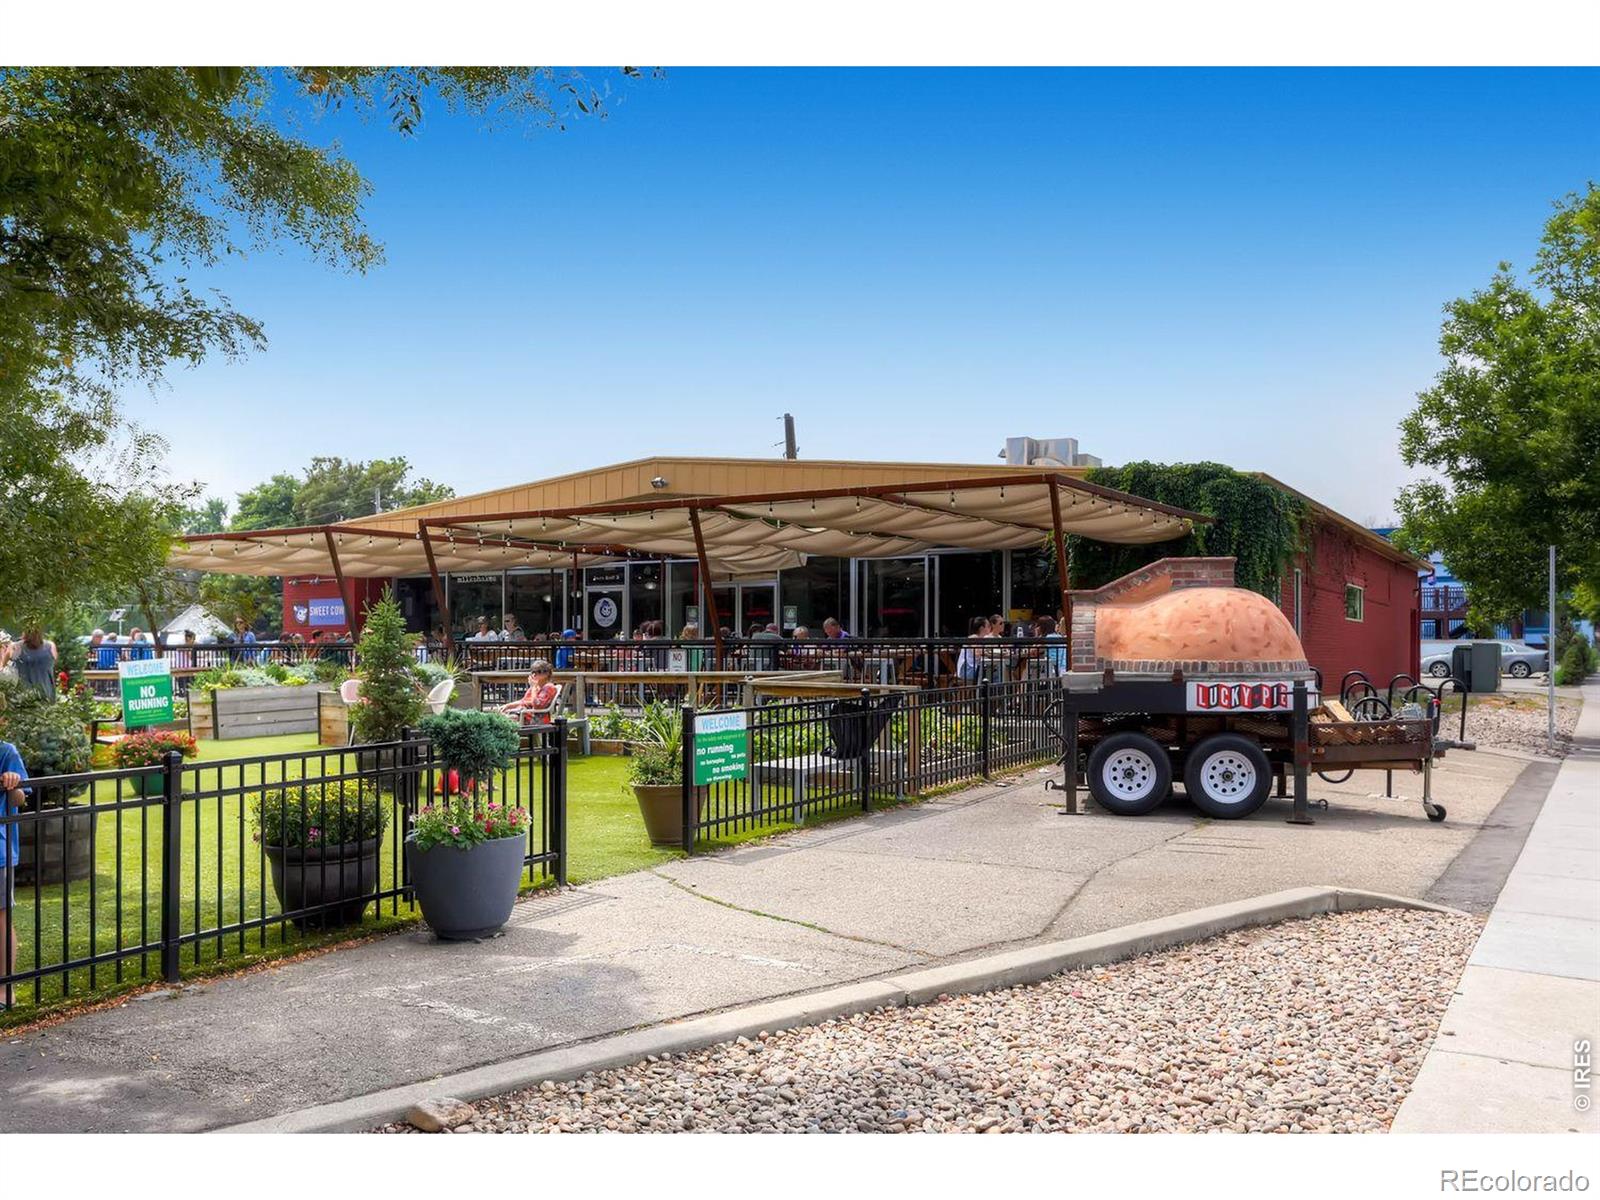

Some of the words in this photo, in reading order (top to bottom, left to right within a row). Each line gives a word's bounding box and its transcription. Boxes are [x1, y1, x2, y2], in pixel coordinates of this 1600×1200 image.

[309, 605, 329, 617] SWEET
[330, 604, 345, 616] COW
[672, 652, 683, 661] NO
[126, 661, 165, 676] WELCOME
[140, 685, 156, 698] NO
[1198, 684, 1251, 707] LUCKY
[1262, 684, 1288, 707] PIE
[128, 696, 169, 711] RUNNING
[702, 715, 741, 730] WELCOME
[707, 743, 734, 754] running
[721, 763, 745, 773] smoking
